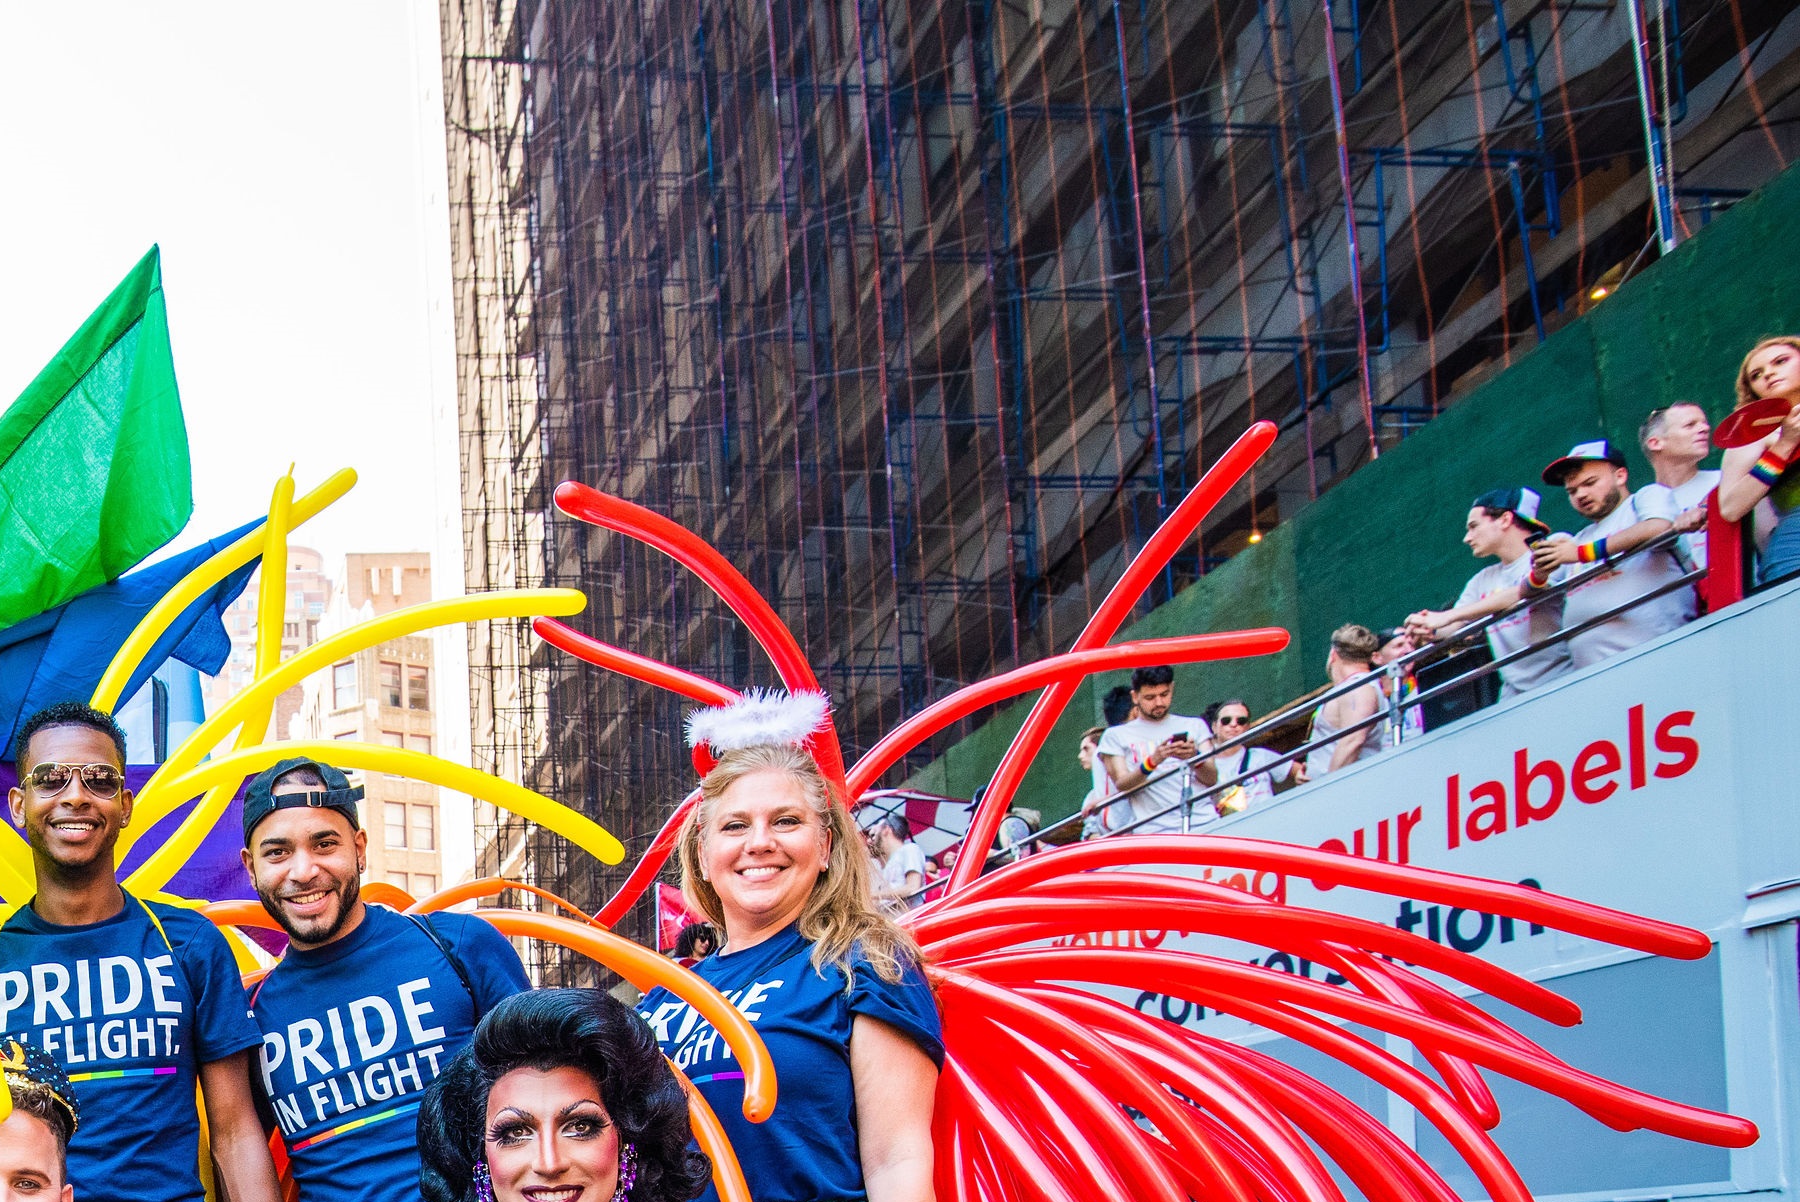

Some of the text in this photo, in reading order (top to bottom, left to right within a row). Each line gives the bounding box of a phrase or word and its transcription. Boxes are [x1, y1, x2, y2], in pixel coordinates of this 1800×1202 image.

[1447, 702, 1700, 851] labels
[43, 1018, 180, 1064] FLIGHT.
[258, 976, 447, 1097] PRIDE
[272, 1044, 446, 1136] IN FLIGHT
